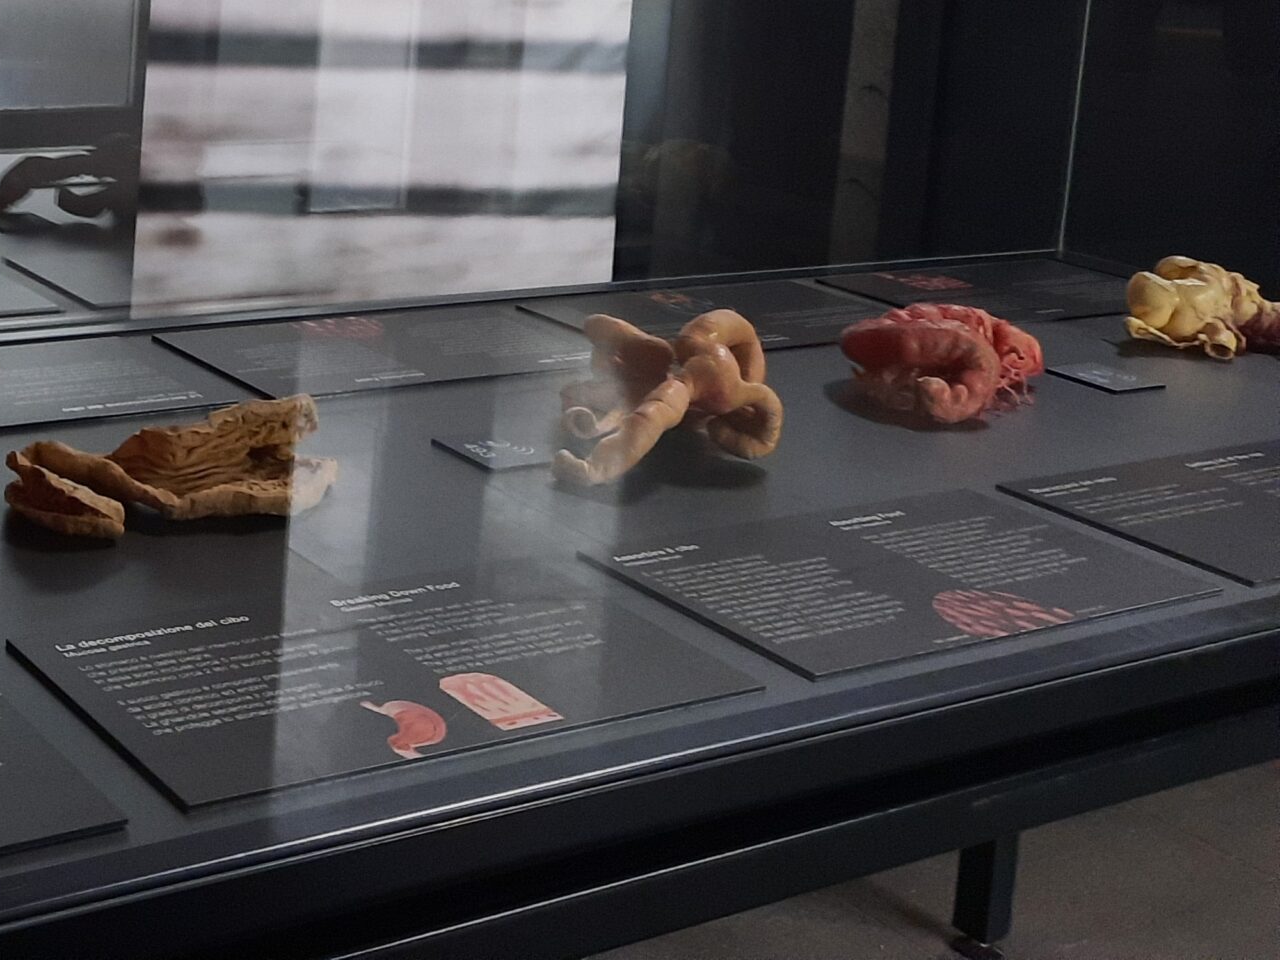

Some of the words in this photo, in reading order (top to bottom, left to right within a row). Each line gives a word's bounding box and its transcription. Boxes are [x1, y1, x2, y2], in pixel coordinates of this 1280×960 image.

[78, 625, 193, 648] decomposizione
[195, 619, 218, 628] del
[219, 616, 249, 624] cibo
